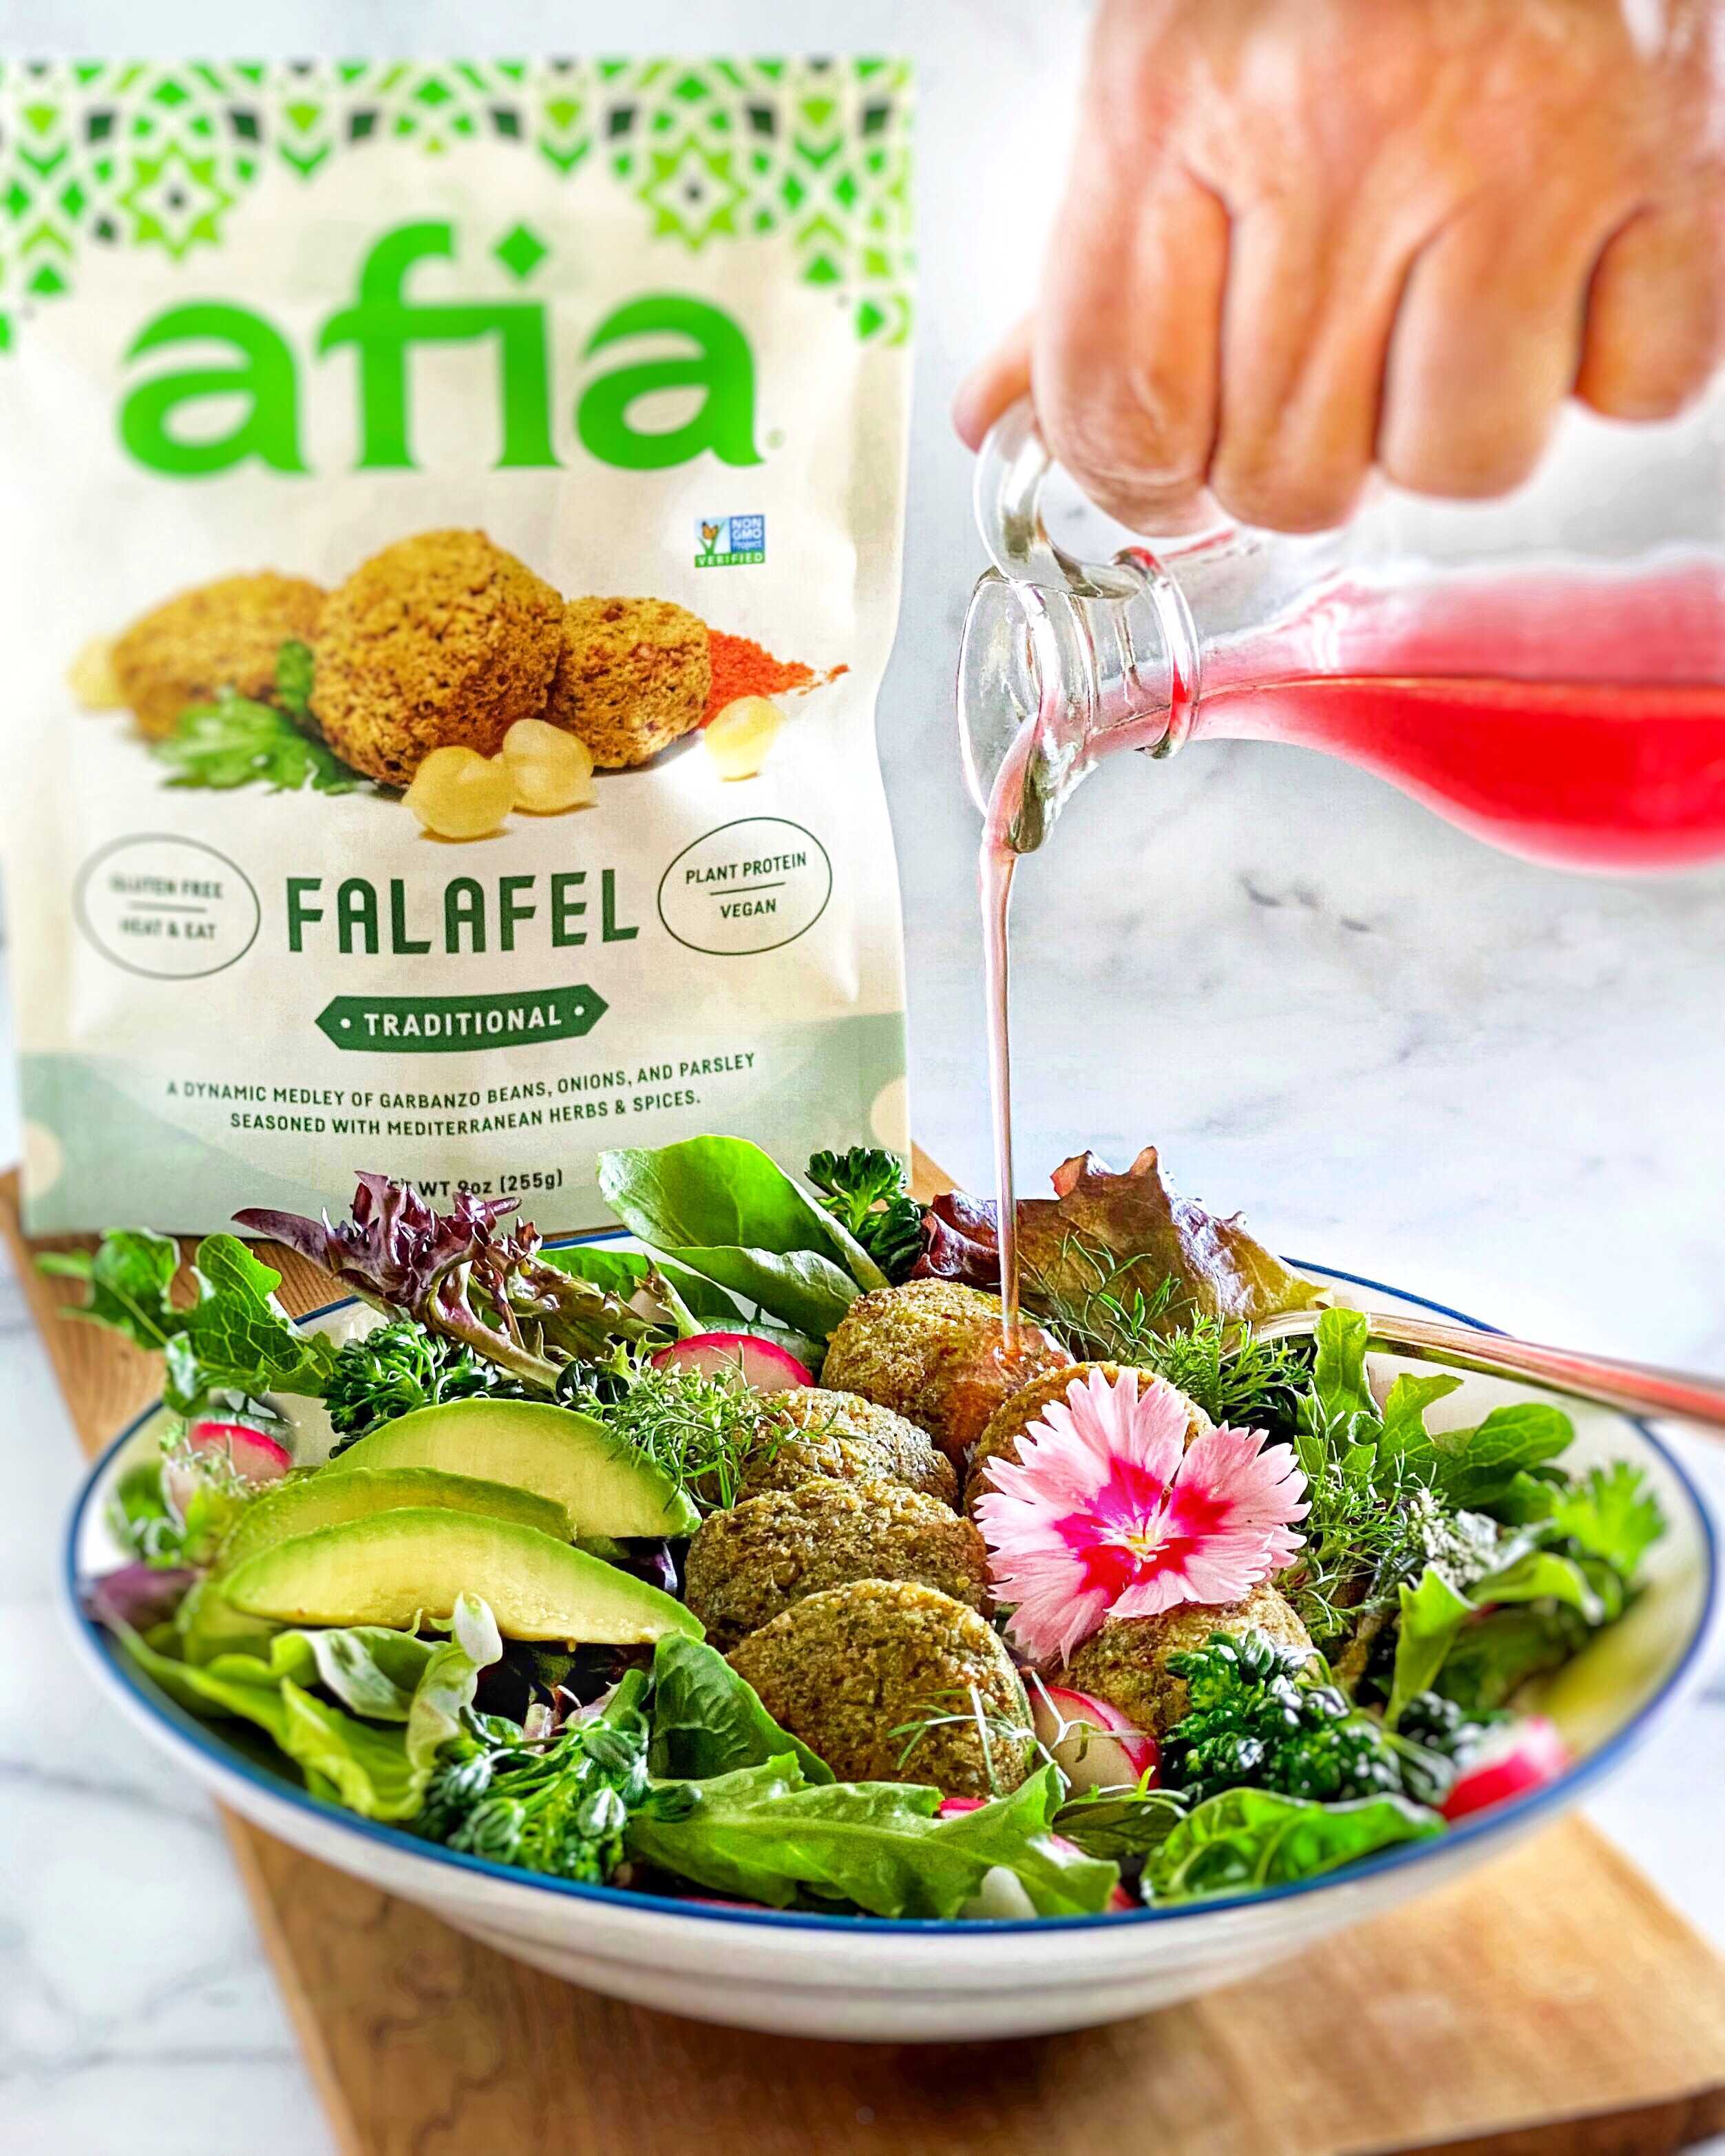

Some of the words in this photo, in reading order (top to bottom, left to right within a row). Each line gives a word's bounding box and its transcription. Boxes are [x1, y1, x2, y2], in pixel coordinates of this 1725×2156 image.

[732, 518, 761, 529] NON
[732, 528, 762, 540] GMO
[686, 864, 738, 884] PLANT
[743, 852, 807, 876] PROTEIN
[286, 869, 639, 954] FALAFEL
[721, 898, 777, 918] VEGAN
[168, 921, 180, 939] &
[184, 921, 217, 940] EAT
[363, 1005, 562, 1037] TRADITIONAL
[167, 1081, 178, 1097] A
[184, 1081, 266, 1101] DYNAMIC
[273, 1088, 345, 1106] MEDLEY
[352, 1092, 374, 1108] OF
[380, 1091, 480, 1109] GARBANZO
[487, 1081, 551, 1103] BEANS,
[558, 1070, 632, 1094] ONIONS,
[637, 1064, 673, 1084] AND
[679, 1052, 755, 1077] PARSLEY
[231, 1112, 325, 1133] SEASONED
[332, 1119, 380, 1136] WITH
[387, 1110, 543, 1136] MEDITERRANEAN
[550, 1100, 608, 1124] HERBS
[615, 1100, 626, 1115] &
[633, 1089, 701, 1113] SPICES.
[419, 1179, 451, 1198] WT
[500, 1168, 563, 1194] (255g)
